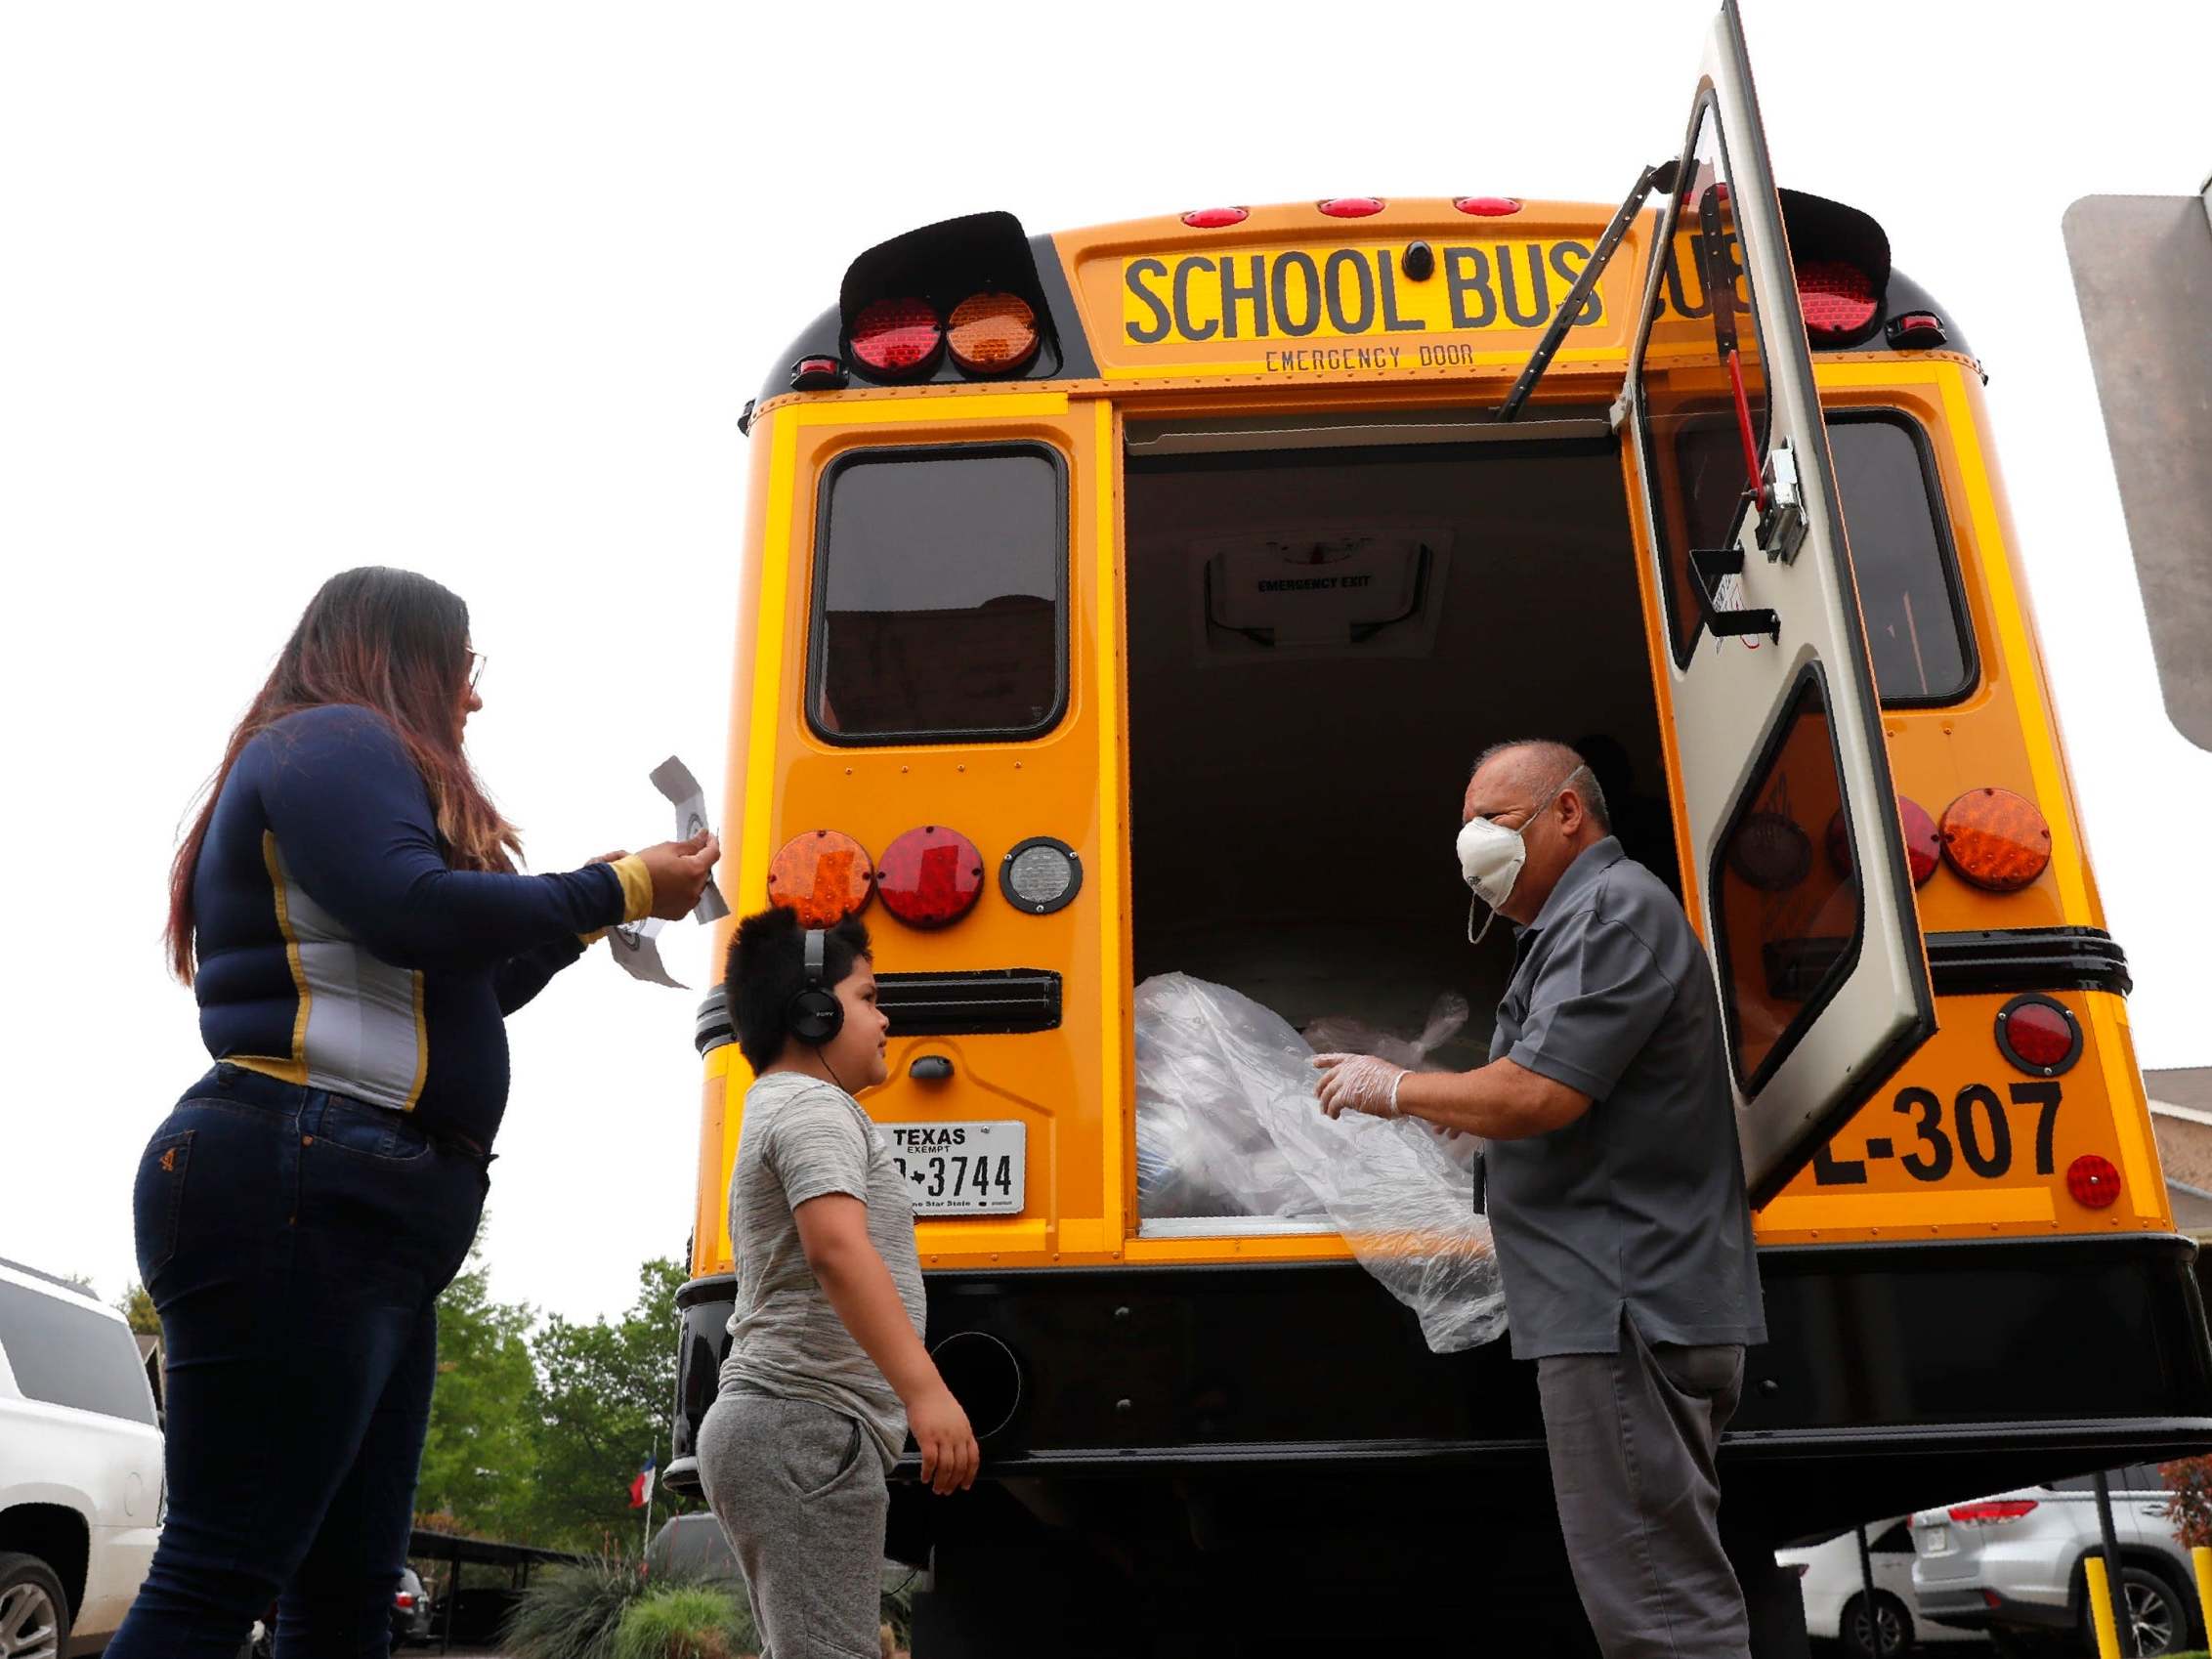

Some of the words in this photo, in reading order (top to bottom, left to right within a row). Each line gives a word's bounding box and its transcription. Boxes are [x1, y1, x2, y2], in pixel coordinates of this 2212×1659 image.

[1126, 248, 1425, 343] SCHOOL
[1443, 241, 1603, 328] BUS
[1266, 346, 1400, 372] EMERGENCY
[1420, 343, 1474, 367] DOOR
[1257, 577, 1338, 592] EMERGENCY
[1340, 574, 1372, 588] EXIT
[893, 1127, 965, 1146] TEXAS
[1812, 1081, 2063, 1185] L-307
